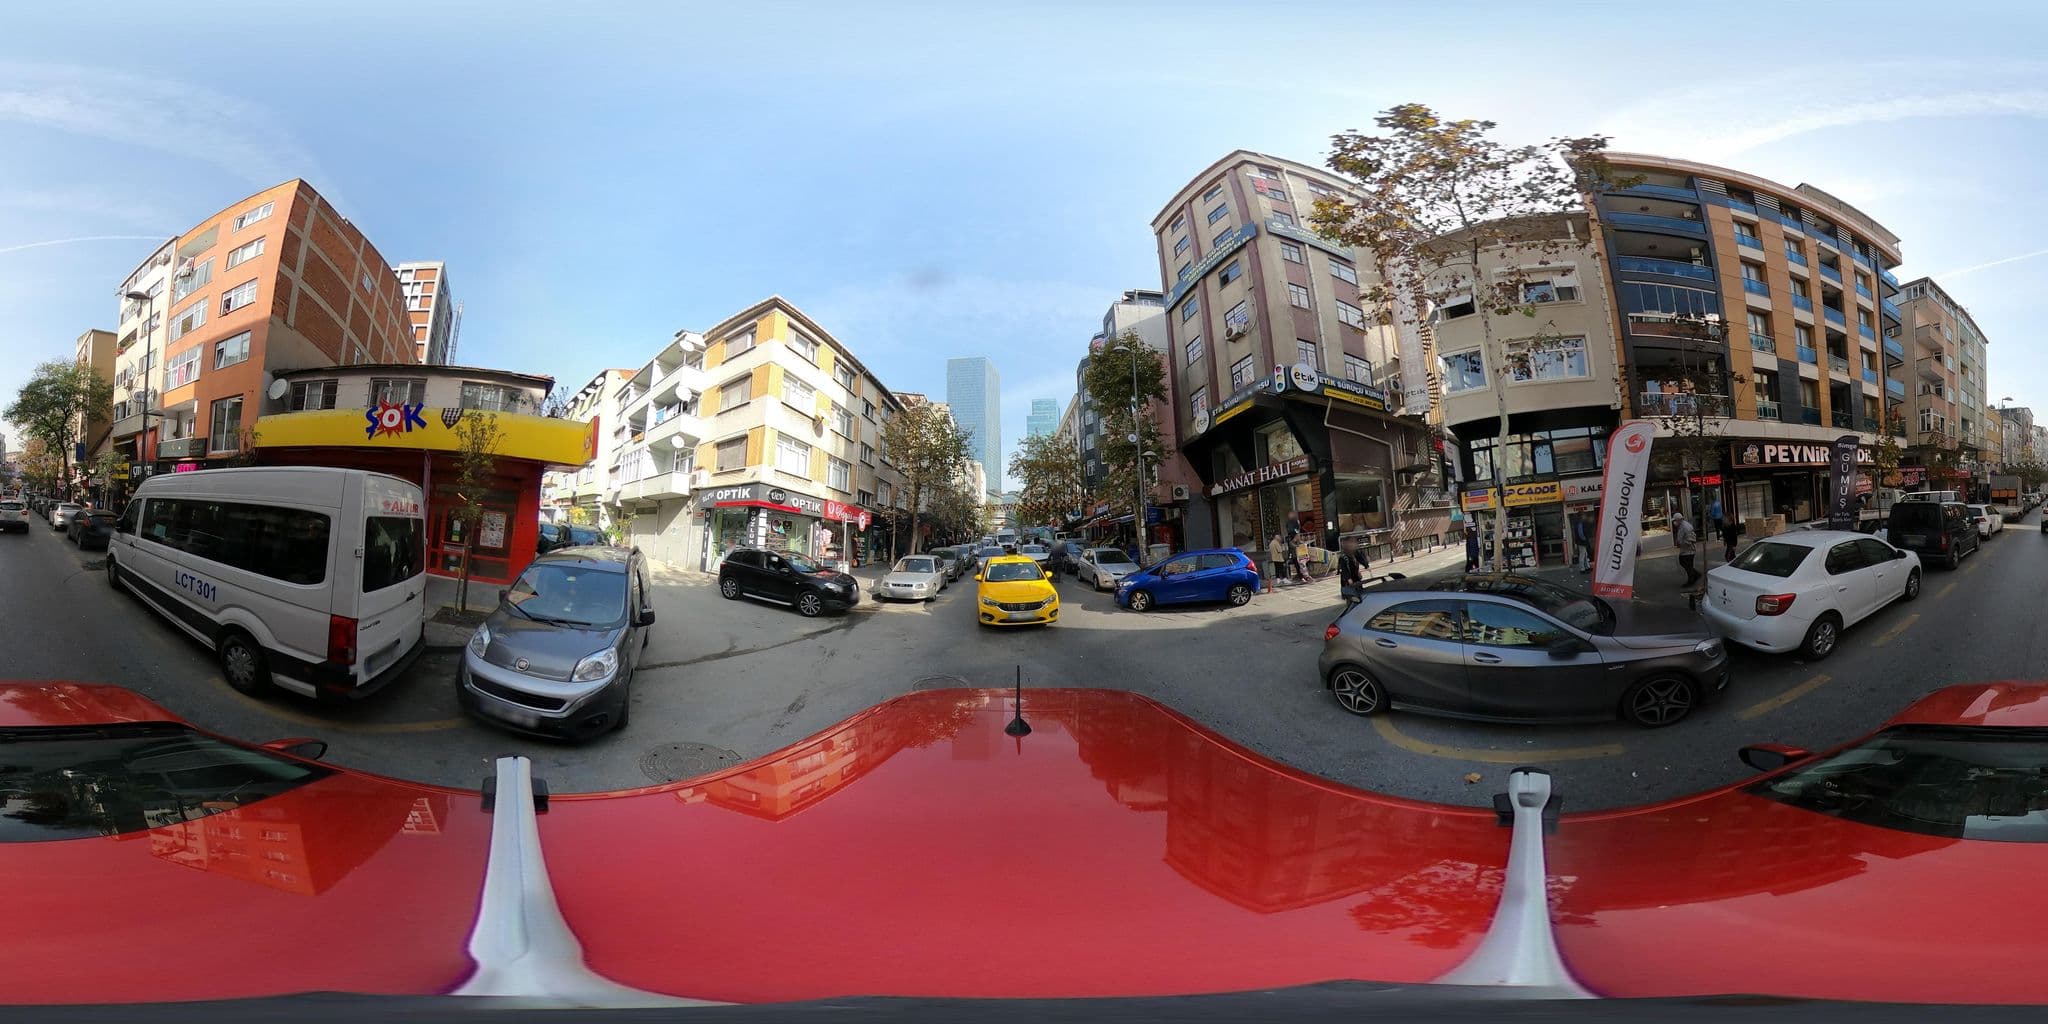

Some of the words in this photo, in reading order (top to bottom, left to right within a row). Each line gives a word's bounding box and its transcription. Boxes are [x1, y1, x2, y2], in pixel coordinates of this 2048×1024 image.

[1294, 371, 1316, 384] etik
[366, 402, 427, 440] ŞOK
[1223, 471, 1257, 492] SANAT
[1260, 461, 1292, 482] HALI
[716, 486, 752, 500] OPTİK
[1516, 484, 1557, 496] CADDE
[1611, 471, 1636, 571] MoneyGram
